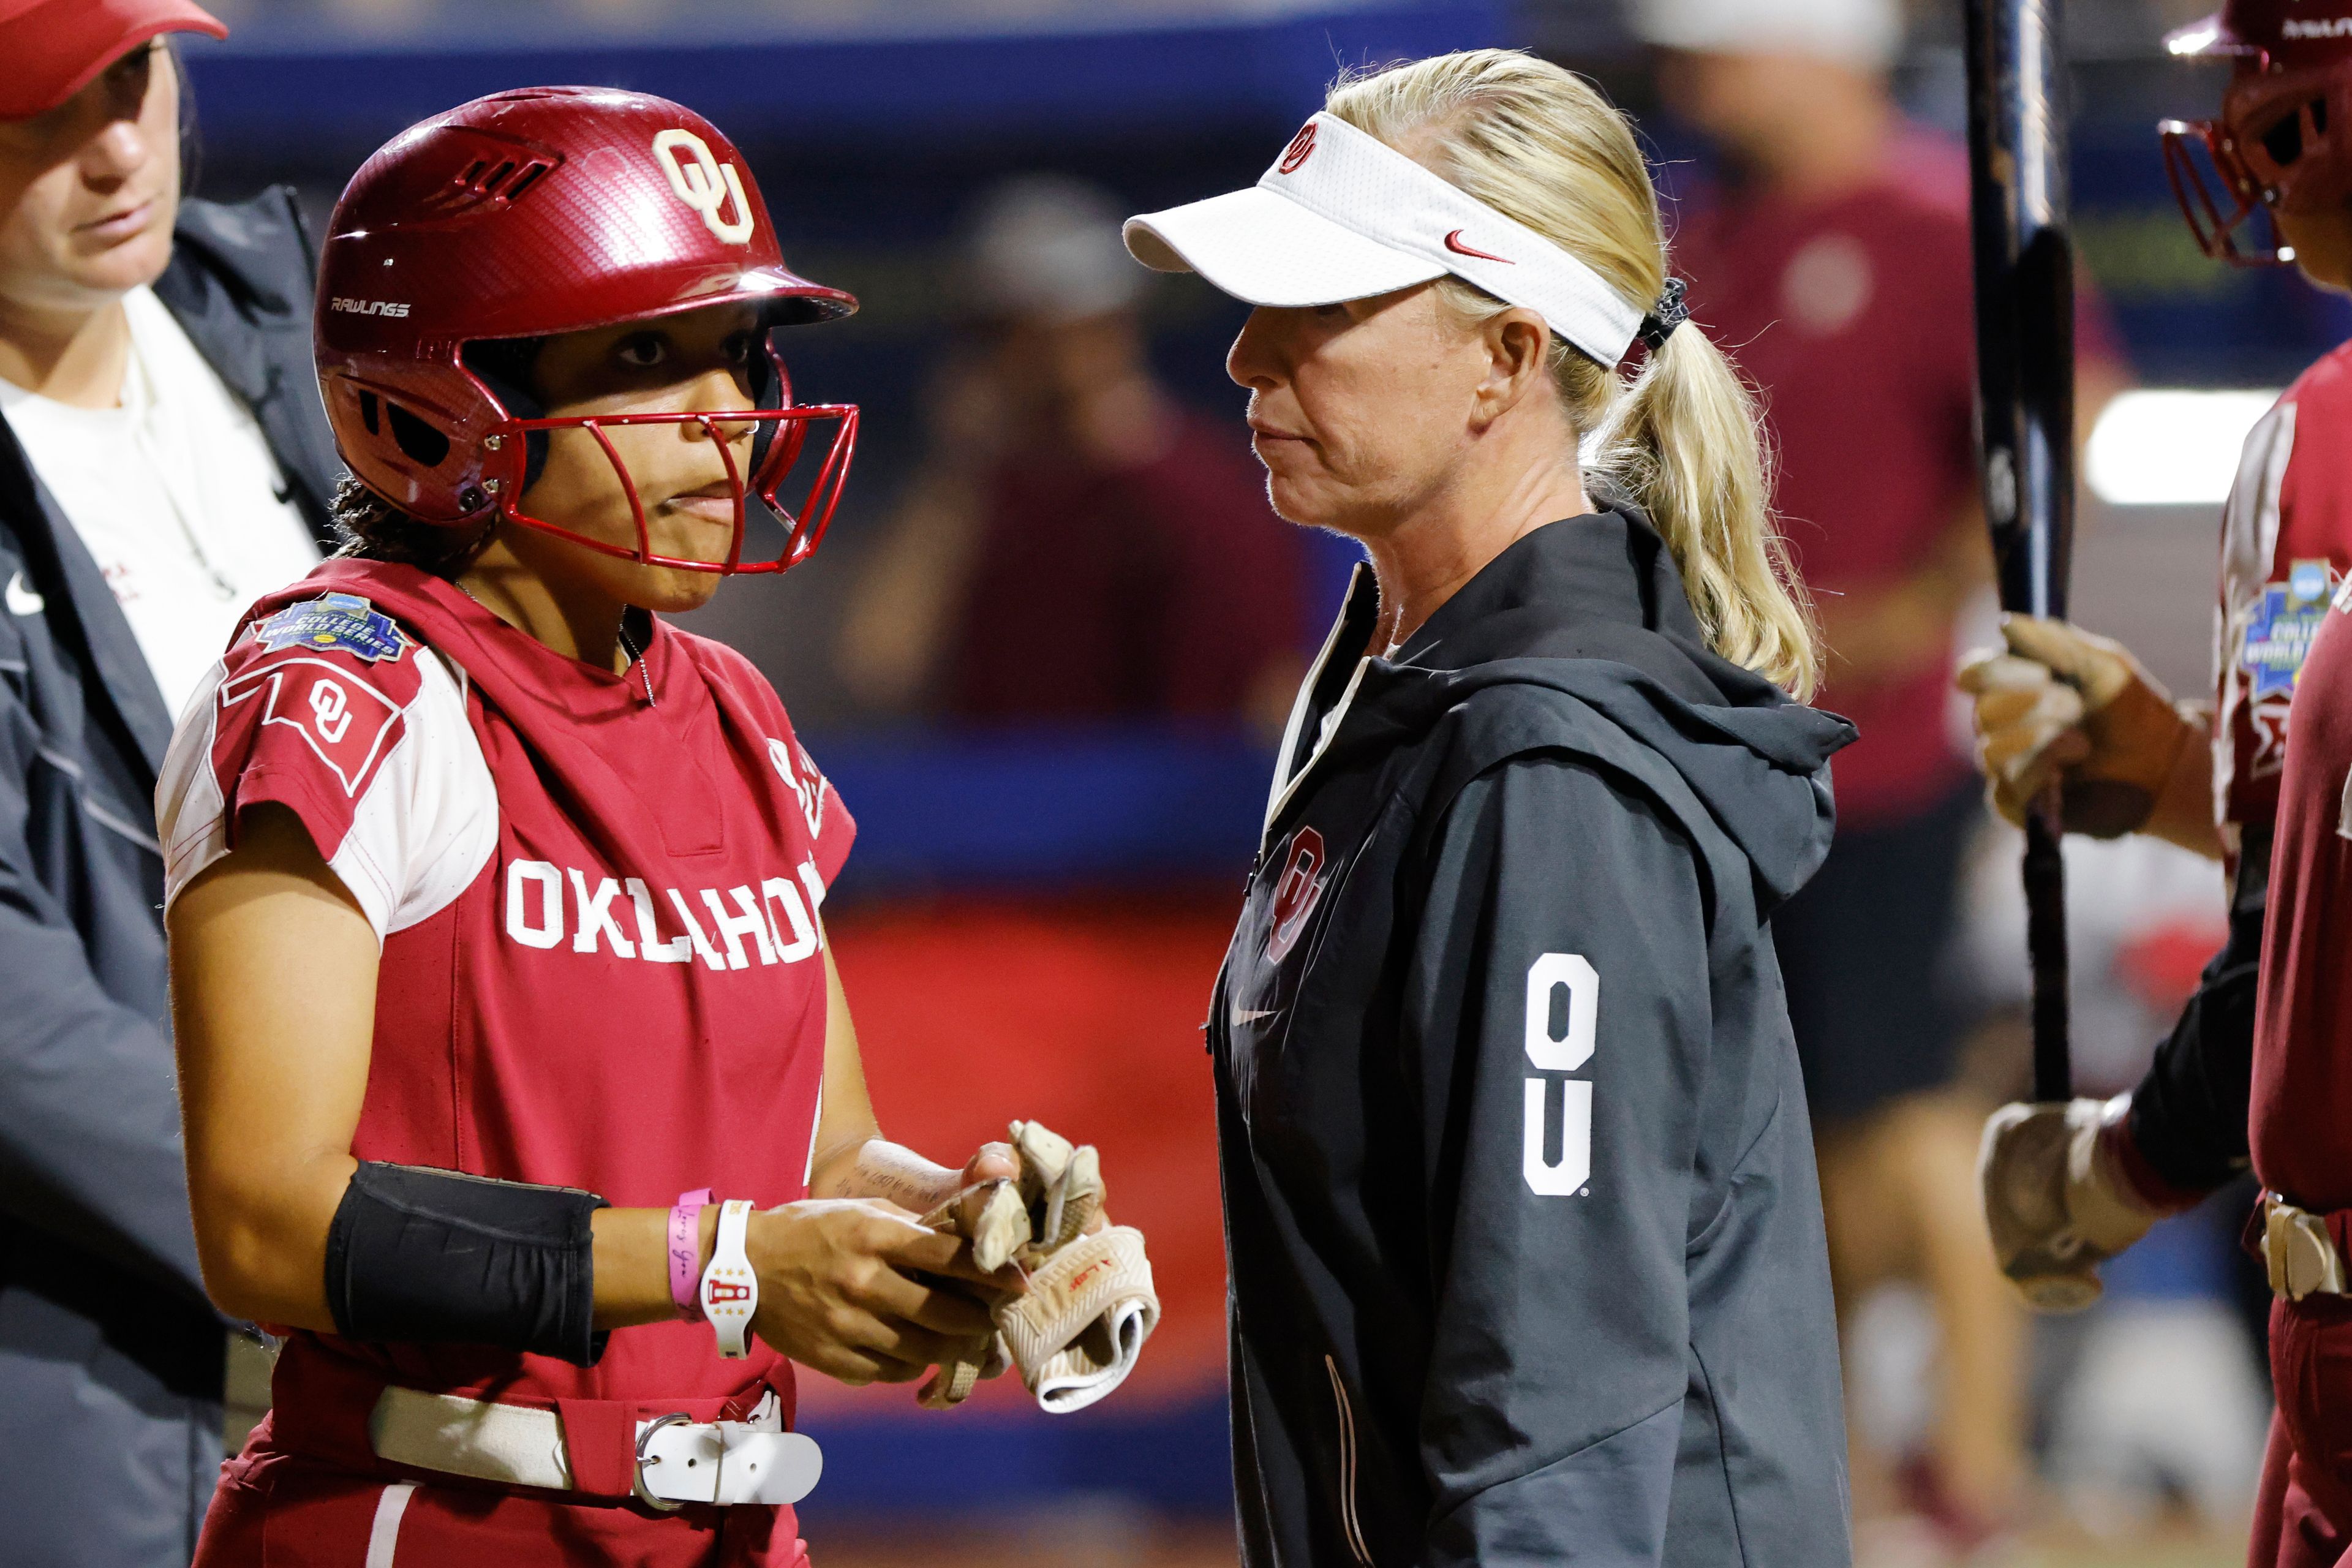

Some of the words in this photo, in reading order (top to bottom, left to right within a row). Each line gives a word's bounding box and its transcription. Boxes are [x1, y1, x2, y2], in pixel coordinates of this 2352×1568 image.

[1278, 122, 1318, 175] OU
[651, 128, 755, 245] OU
[331, 296, 412, 318] RAWLINGS
[265, 623, 331, 638] WORLD
[331, 625, 395, 654] SERIES
[295, 616, 375, 636] COLLEGE
[309, 678, 353, 744] OU
[1267, 825, 1325, 966] OU
